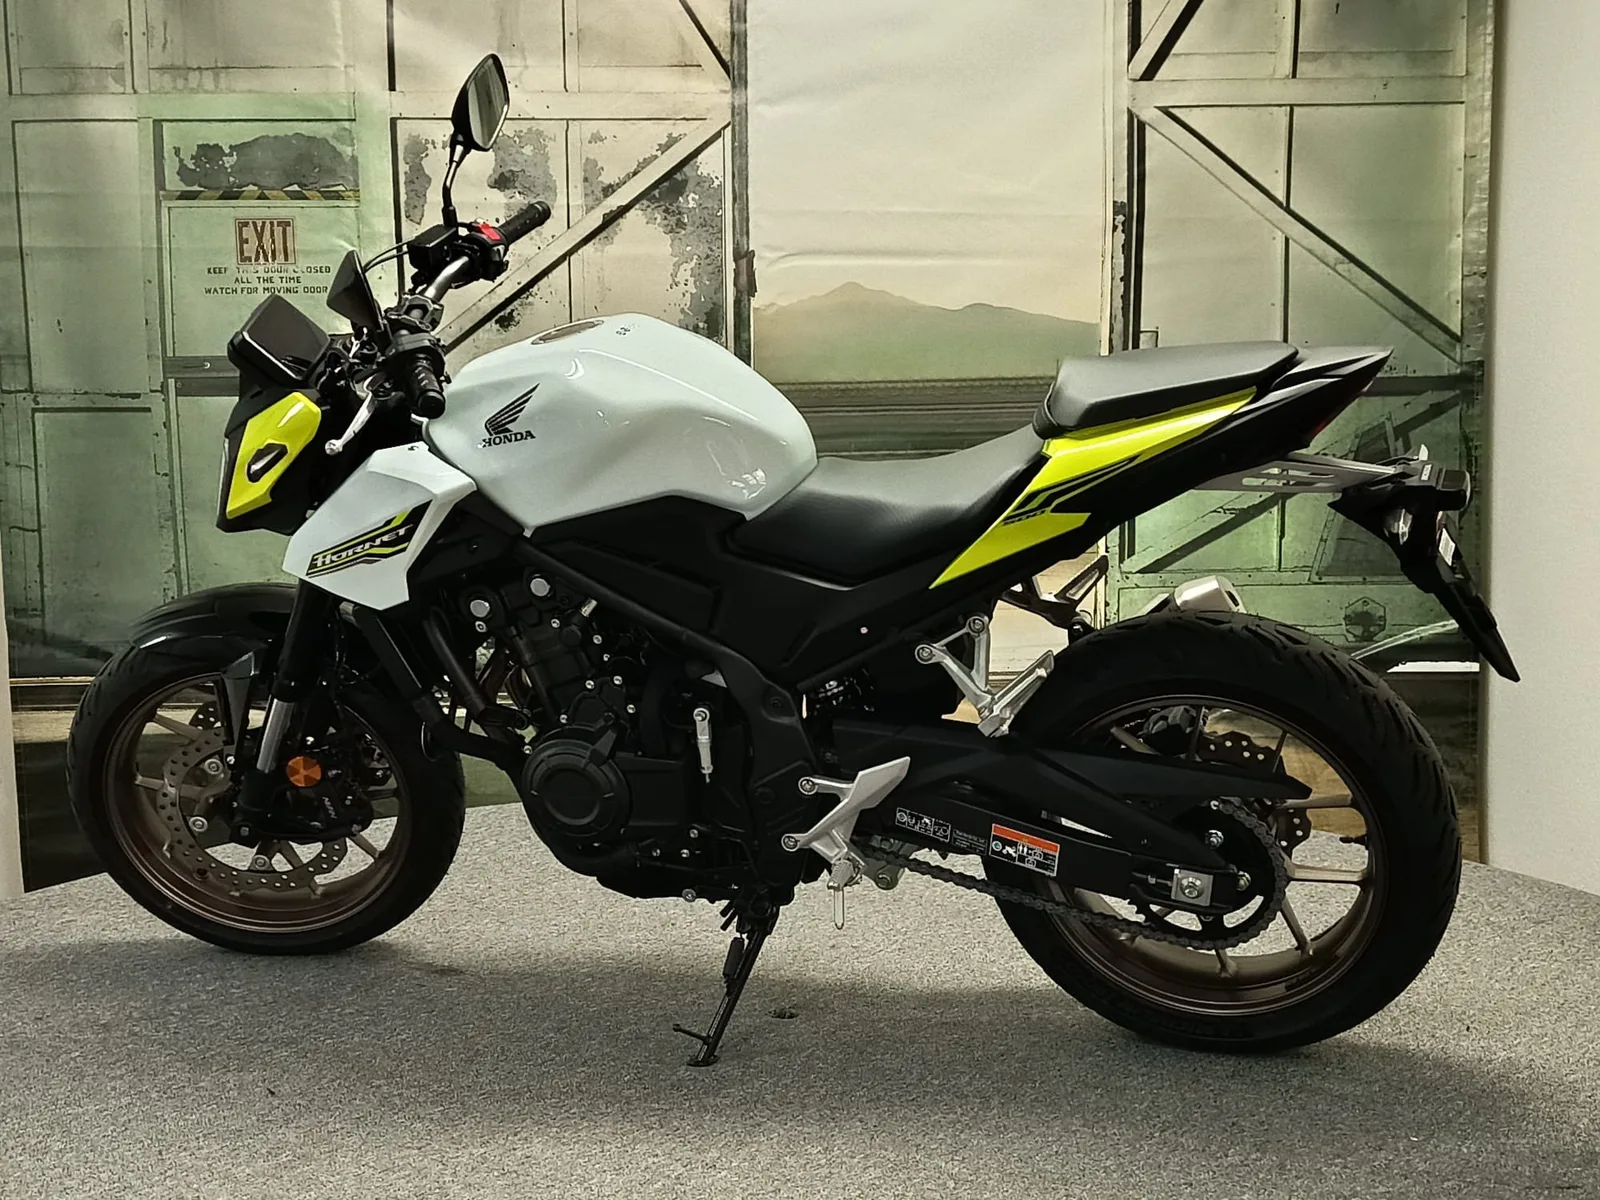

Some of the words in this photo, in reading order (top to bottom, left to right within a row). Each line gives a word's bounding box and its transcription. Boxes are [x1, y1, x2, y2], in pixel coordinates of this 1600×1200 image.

[238, 220, 291, 262] EXIT
[236, 266, 259, 274] TS
[234, 276, 252, 284] ALL
[256, 276, 275, 284] THE
[278, 276, 302, 284] TIME
[240, 286, 259, 294] FOR
[262, 286, 299, 294] MOVING
[303, 286, 328, 294] DOOR
[480, 430, 536, 448] HONDA
[312, 523, 414, 567] HORNET
